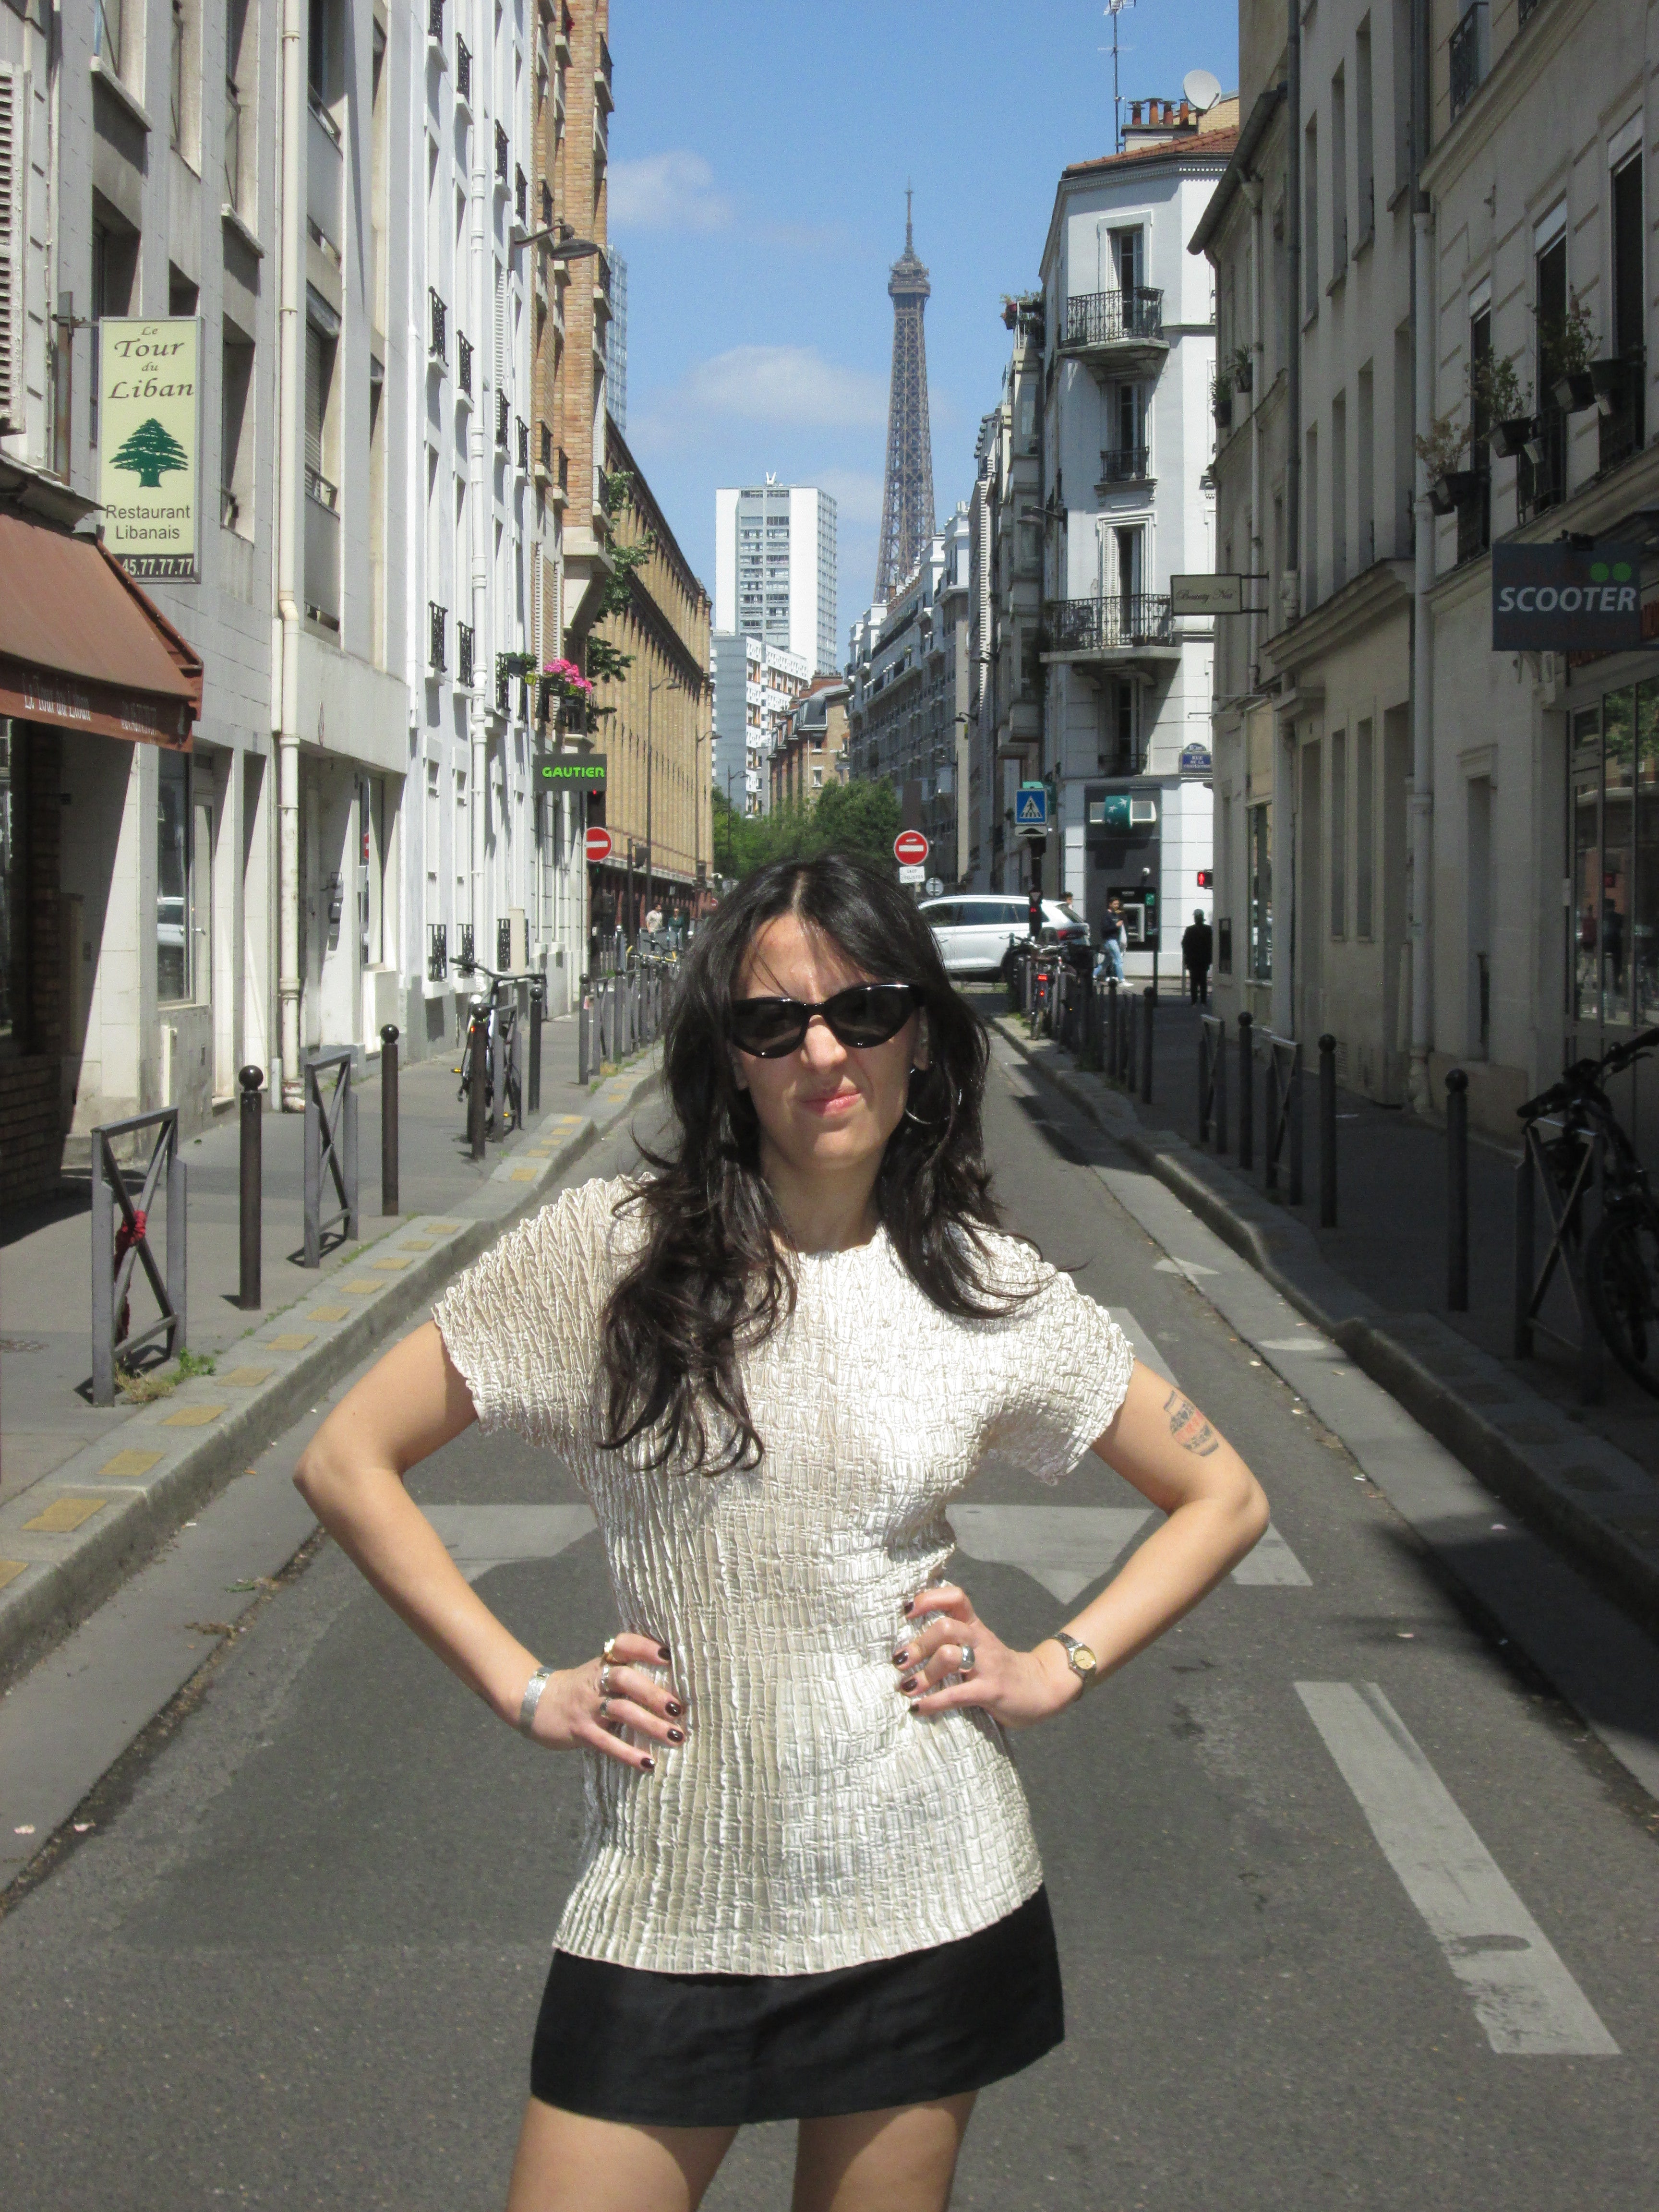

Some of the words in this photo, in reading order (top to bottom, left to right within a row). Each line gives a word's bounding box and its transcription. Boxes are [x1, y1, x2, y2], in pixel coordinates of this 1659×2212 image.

[142, 326, 158, 336] Le
[114, 337, 185, 359] Tour
[141, 362, 158, 372] du
[108, 377, 194, 399] Liban
[106, 504, 191, 519] Restaurant
[116, 525, 180, 540] Libanais
[1498, 586, 1636, 612] SCOOTER
[541, 766, 605, 778] GAUTIER
